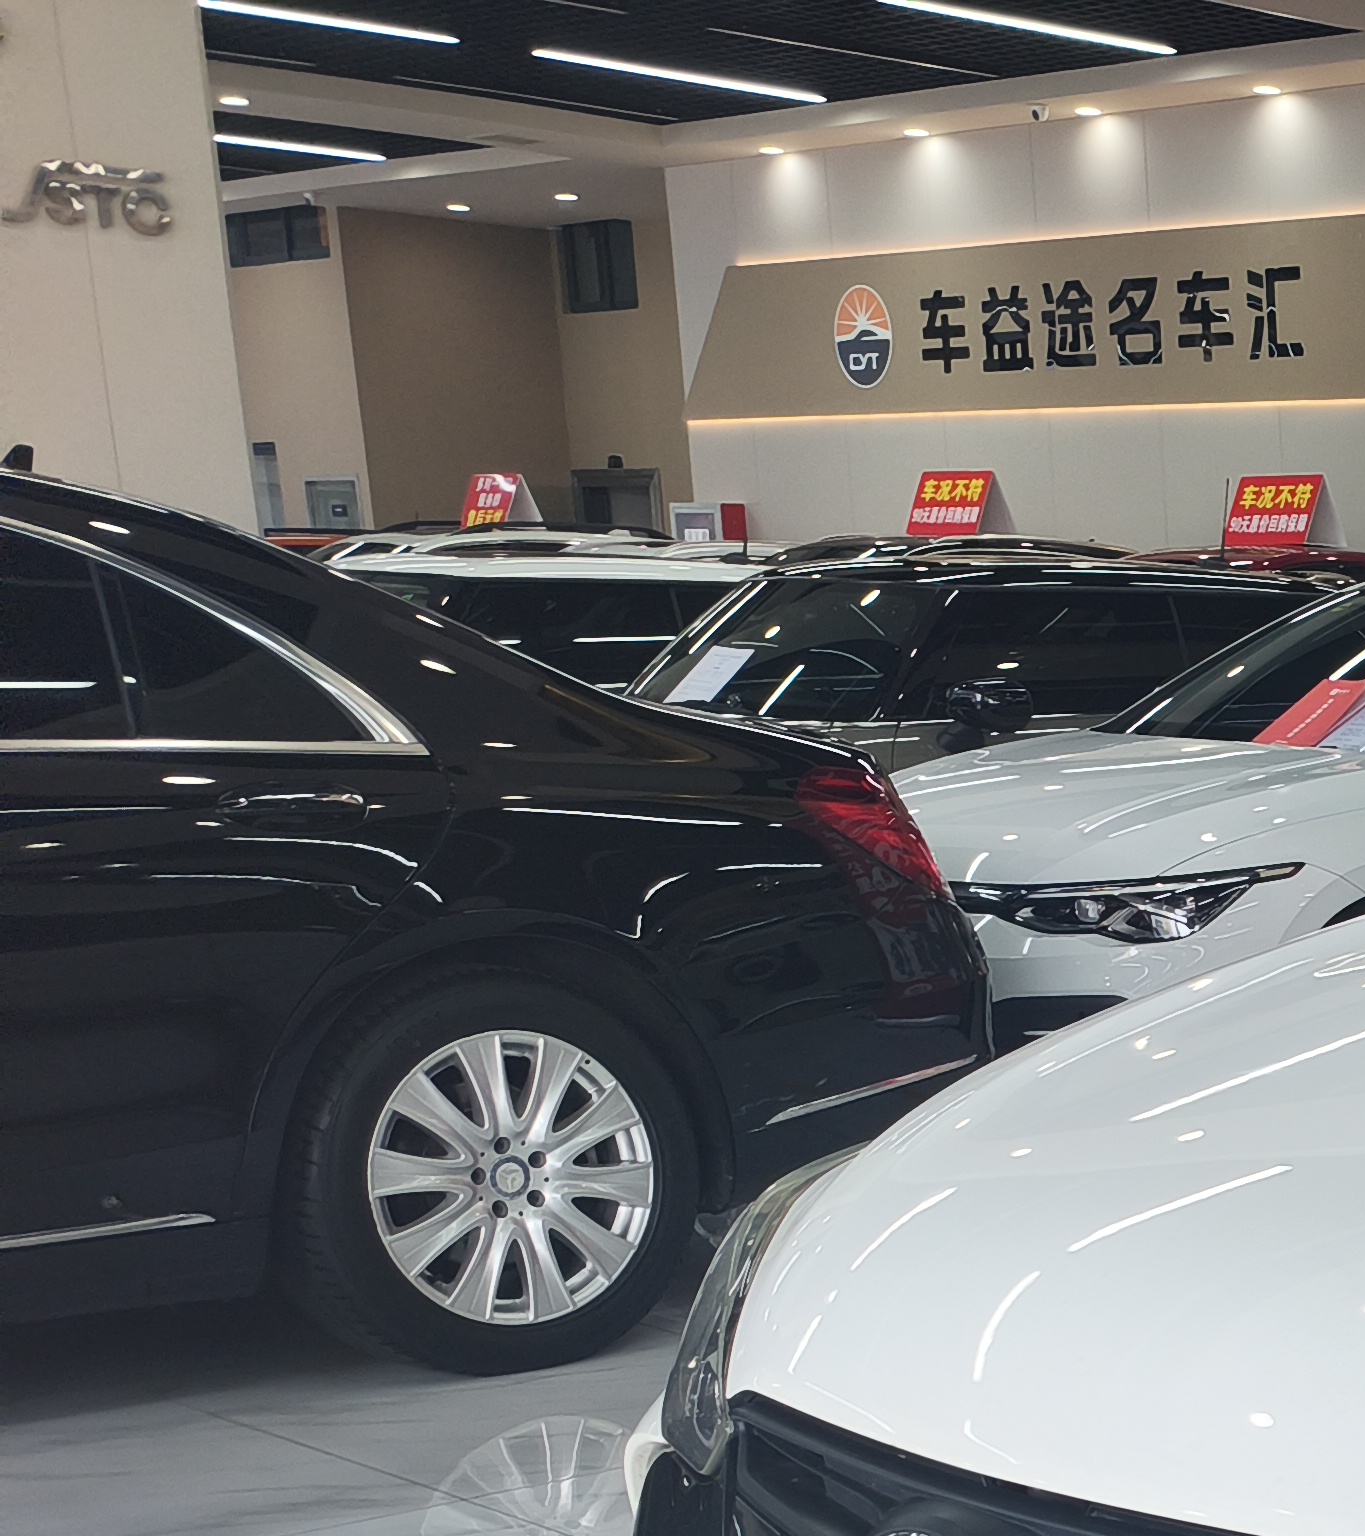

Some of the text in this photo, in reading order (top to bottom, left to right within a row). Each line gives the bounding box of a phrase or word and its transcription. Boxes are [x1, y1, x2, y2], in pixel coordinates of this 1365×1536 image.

[919, 265, 1304, 374] 车益途名车汇
[921, 478, 985, 502] 车况不符
[1239, 482, 1314, 510] 车况不符
